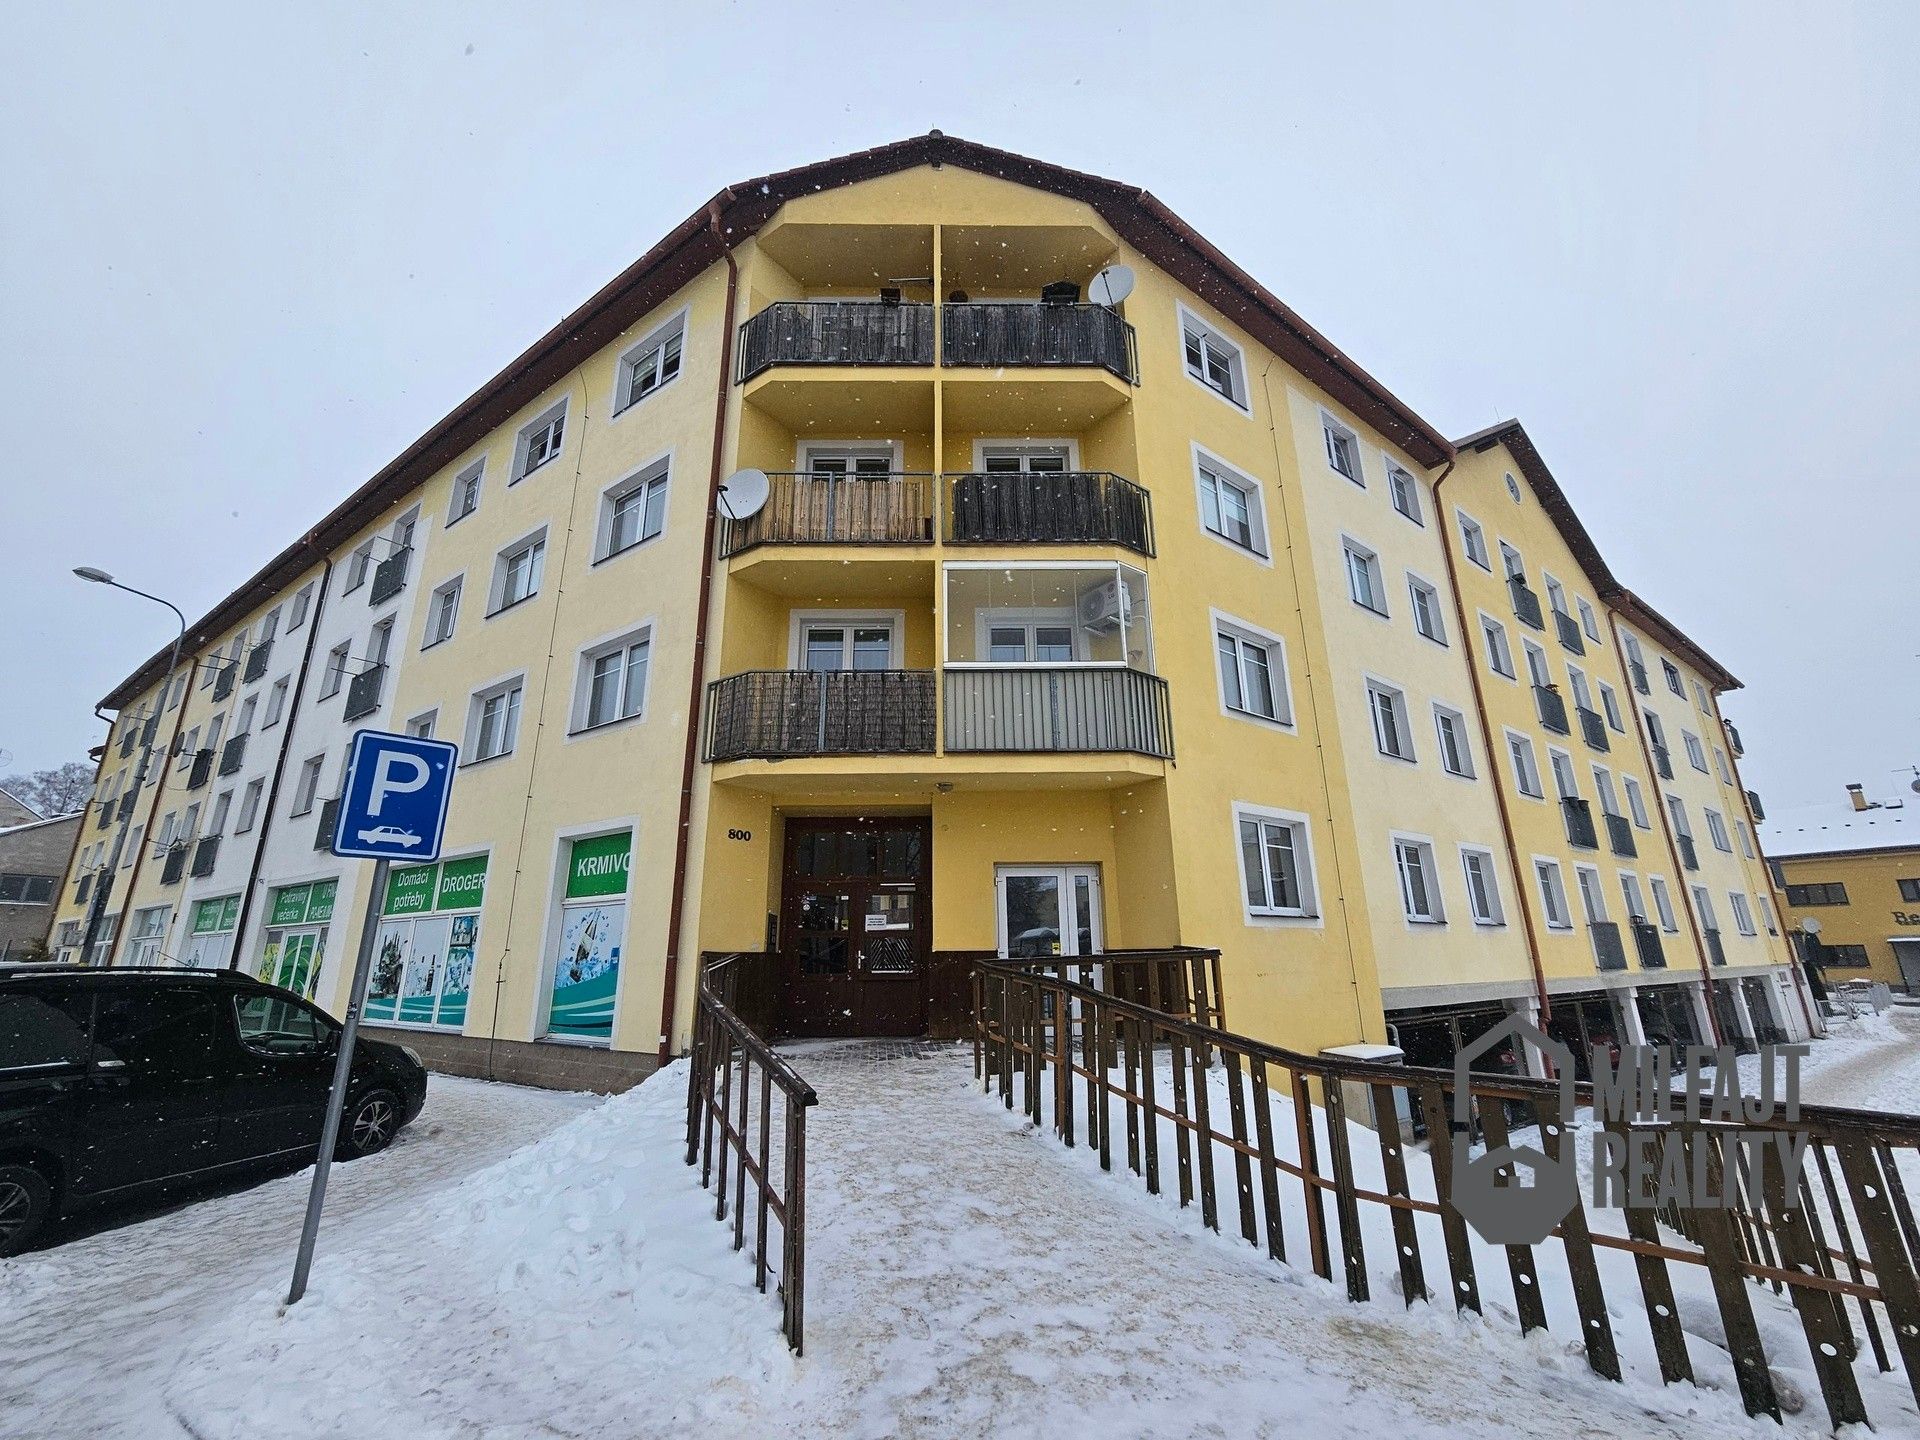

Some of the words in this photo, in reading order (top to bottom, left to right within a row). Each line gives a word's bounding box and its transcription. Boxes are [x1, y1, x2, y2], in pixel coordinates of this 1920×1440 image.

[366, 750, 431, 816] P
[728, 829, 751, 841] 800
[397, 868, 430, 887] Domácí
[393, 891, 426, 911] potřeby
